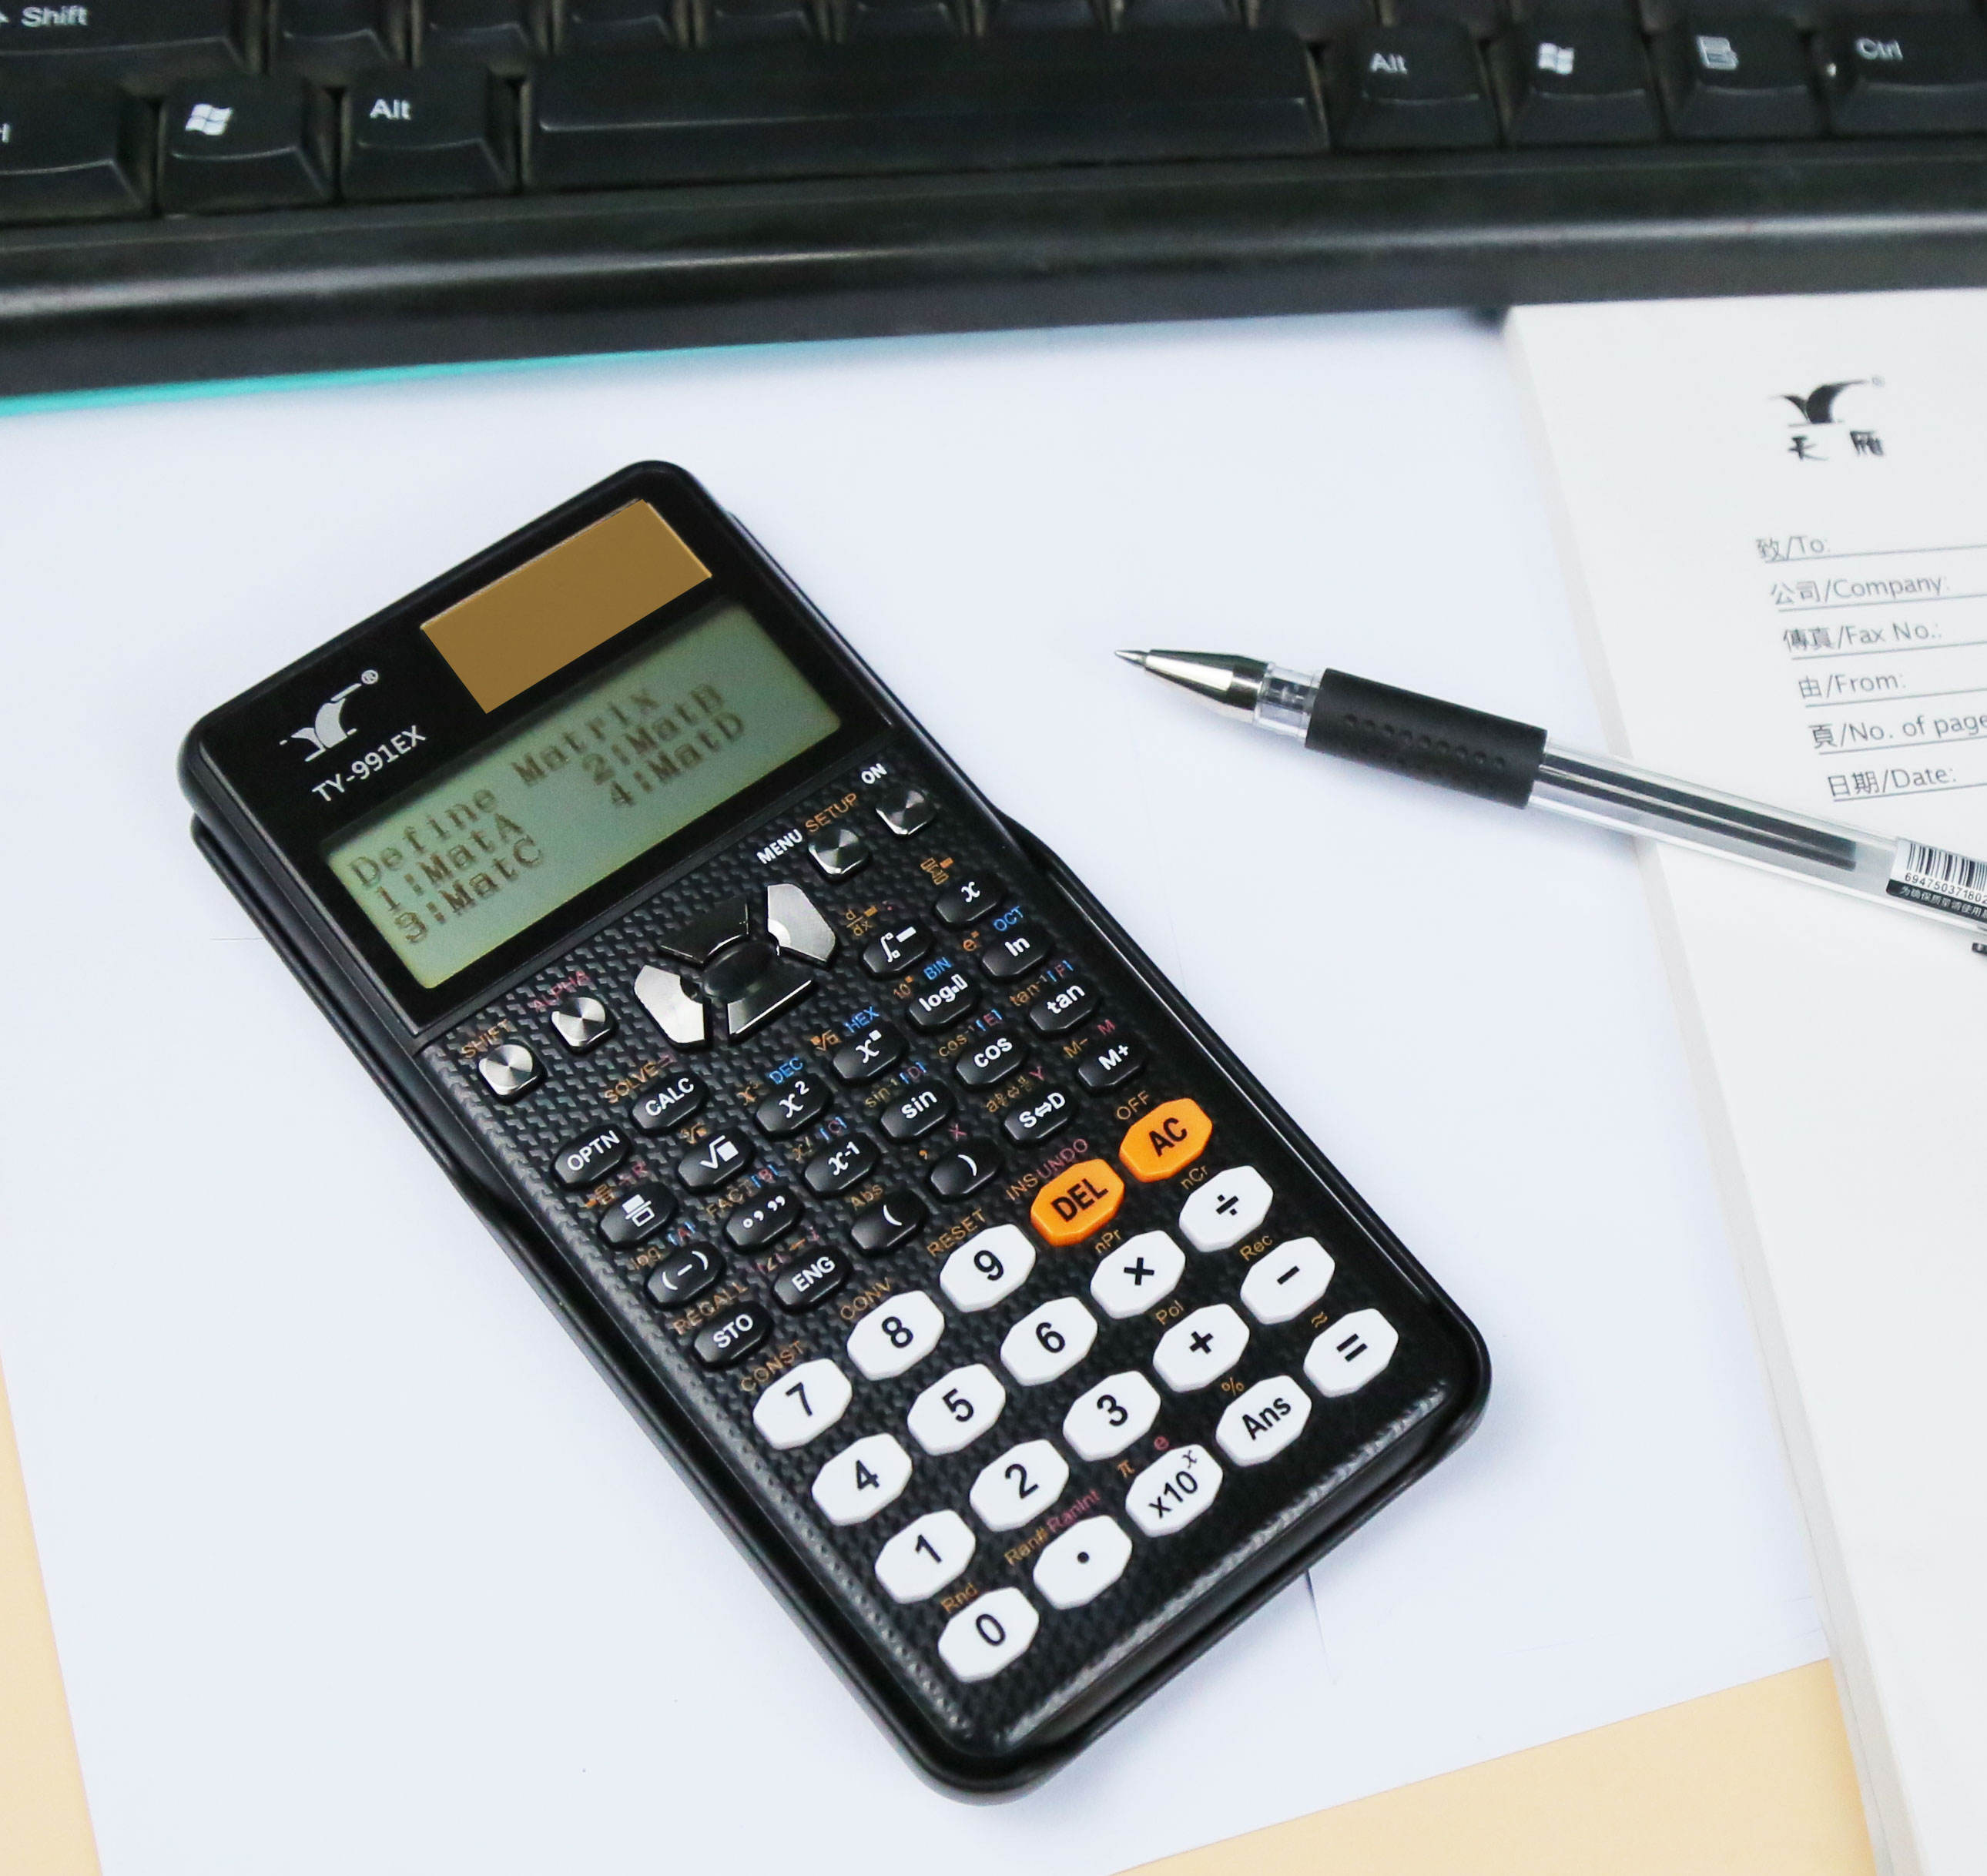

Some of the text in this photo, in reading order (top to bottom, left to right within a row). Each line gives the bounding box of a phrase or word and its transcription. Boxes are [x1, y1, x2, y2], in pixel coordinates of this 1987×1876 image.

[22, 5, 88, 27] Shift
[1369, 52, 1409, 74] Alt
[1855, 37, 1903, 61] Ctrl
[370, 99, 413, 122] Alt
[1771, 576, 1950, 606] 公司/Company:
[1798, 672, 1907, 699] 由/From:
[1902, 713, 1928, 738] of
[311, 725, 427, 802] TY-991EX
[861, 762, 887, 785] ON
[1828, 766, 1958, 798] 日期/Date:
[348, 789, 496, 888] Define
[756, 792, 858, 865] MENU SETUP
[993, 905, 1024, 932] OCT
[923, 956, 953, 980] BIN
[1047, 985, 1086, 1014] tan
[843, 1006, 880, 1034] HEX
[1097, 1018, 1116, 1036] M
[973, 1037, 1013, 1068] cos
[1098, 1044, 1129, 1070] M+
[767, 1056, 803, 1084] DEC
[645, 1078, 695, 1116] CALC
[901, 1090, 938, 1119] sin
[1116, 1090, 1150, 1121] OFF
[567, 1130, 621, 1171] OPTN
[1148, 1117, 1188, 1157] AC
[1006, 1138, 1088, 1201] INS UNDO
[1180, 1165, 1208, 1191] nCr
[1050, 1178, 1109, 1222] DEL
[926, 1207, 988, 1258] RESET
[1094, 1229, 1122, 1255] nPr
[1239, 1235, 1273, 1261] Rec
[792, 1256, 836, 1292] ENG
[973, 1250, 1004, 1281] 9
[840, 1276, 893, 1322] CONV
[1155, 1300, 1184, 1325] Pol
[713, 1314, 754, 1349] STO
[881, 1316, 913, 1348] 8
[1036, 1322, 1065, 1353] 6
[740, 1340, 806, 1393] CONST
[786, 1382, 813, 1416] 7
[942, 1388, 974, 1422] 5
[1097, 1395, 1128, 1427] 3
[1241, 1397, 1292, 1441] Ans
[855, 1459, 880, 1490] 4
[1005, 1464, 1039, 1499] 2
[915, 1534, 942, 1564] 1
[940, 1583, 978, 1614] Rnd
[975, 1614, 1006, 1646] 0
